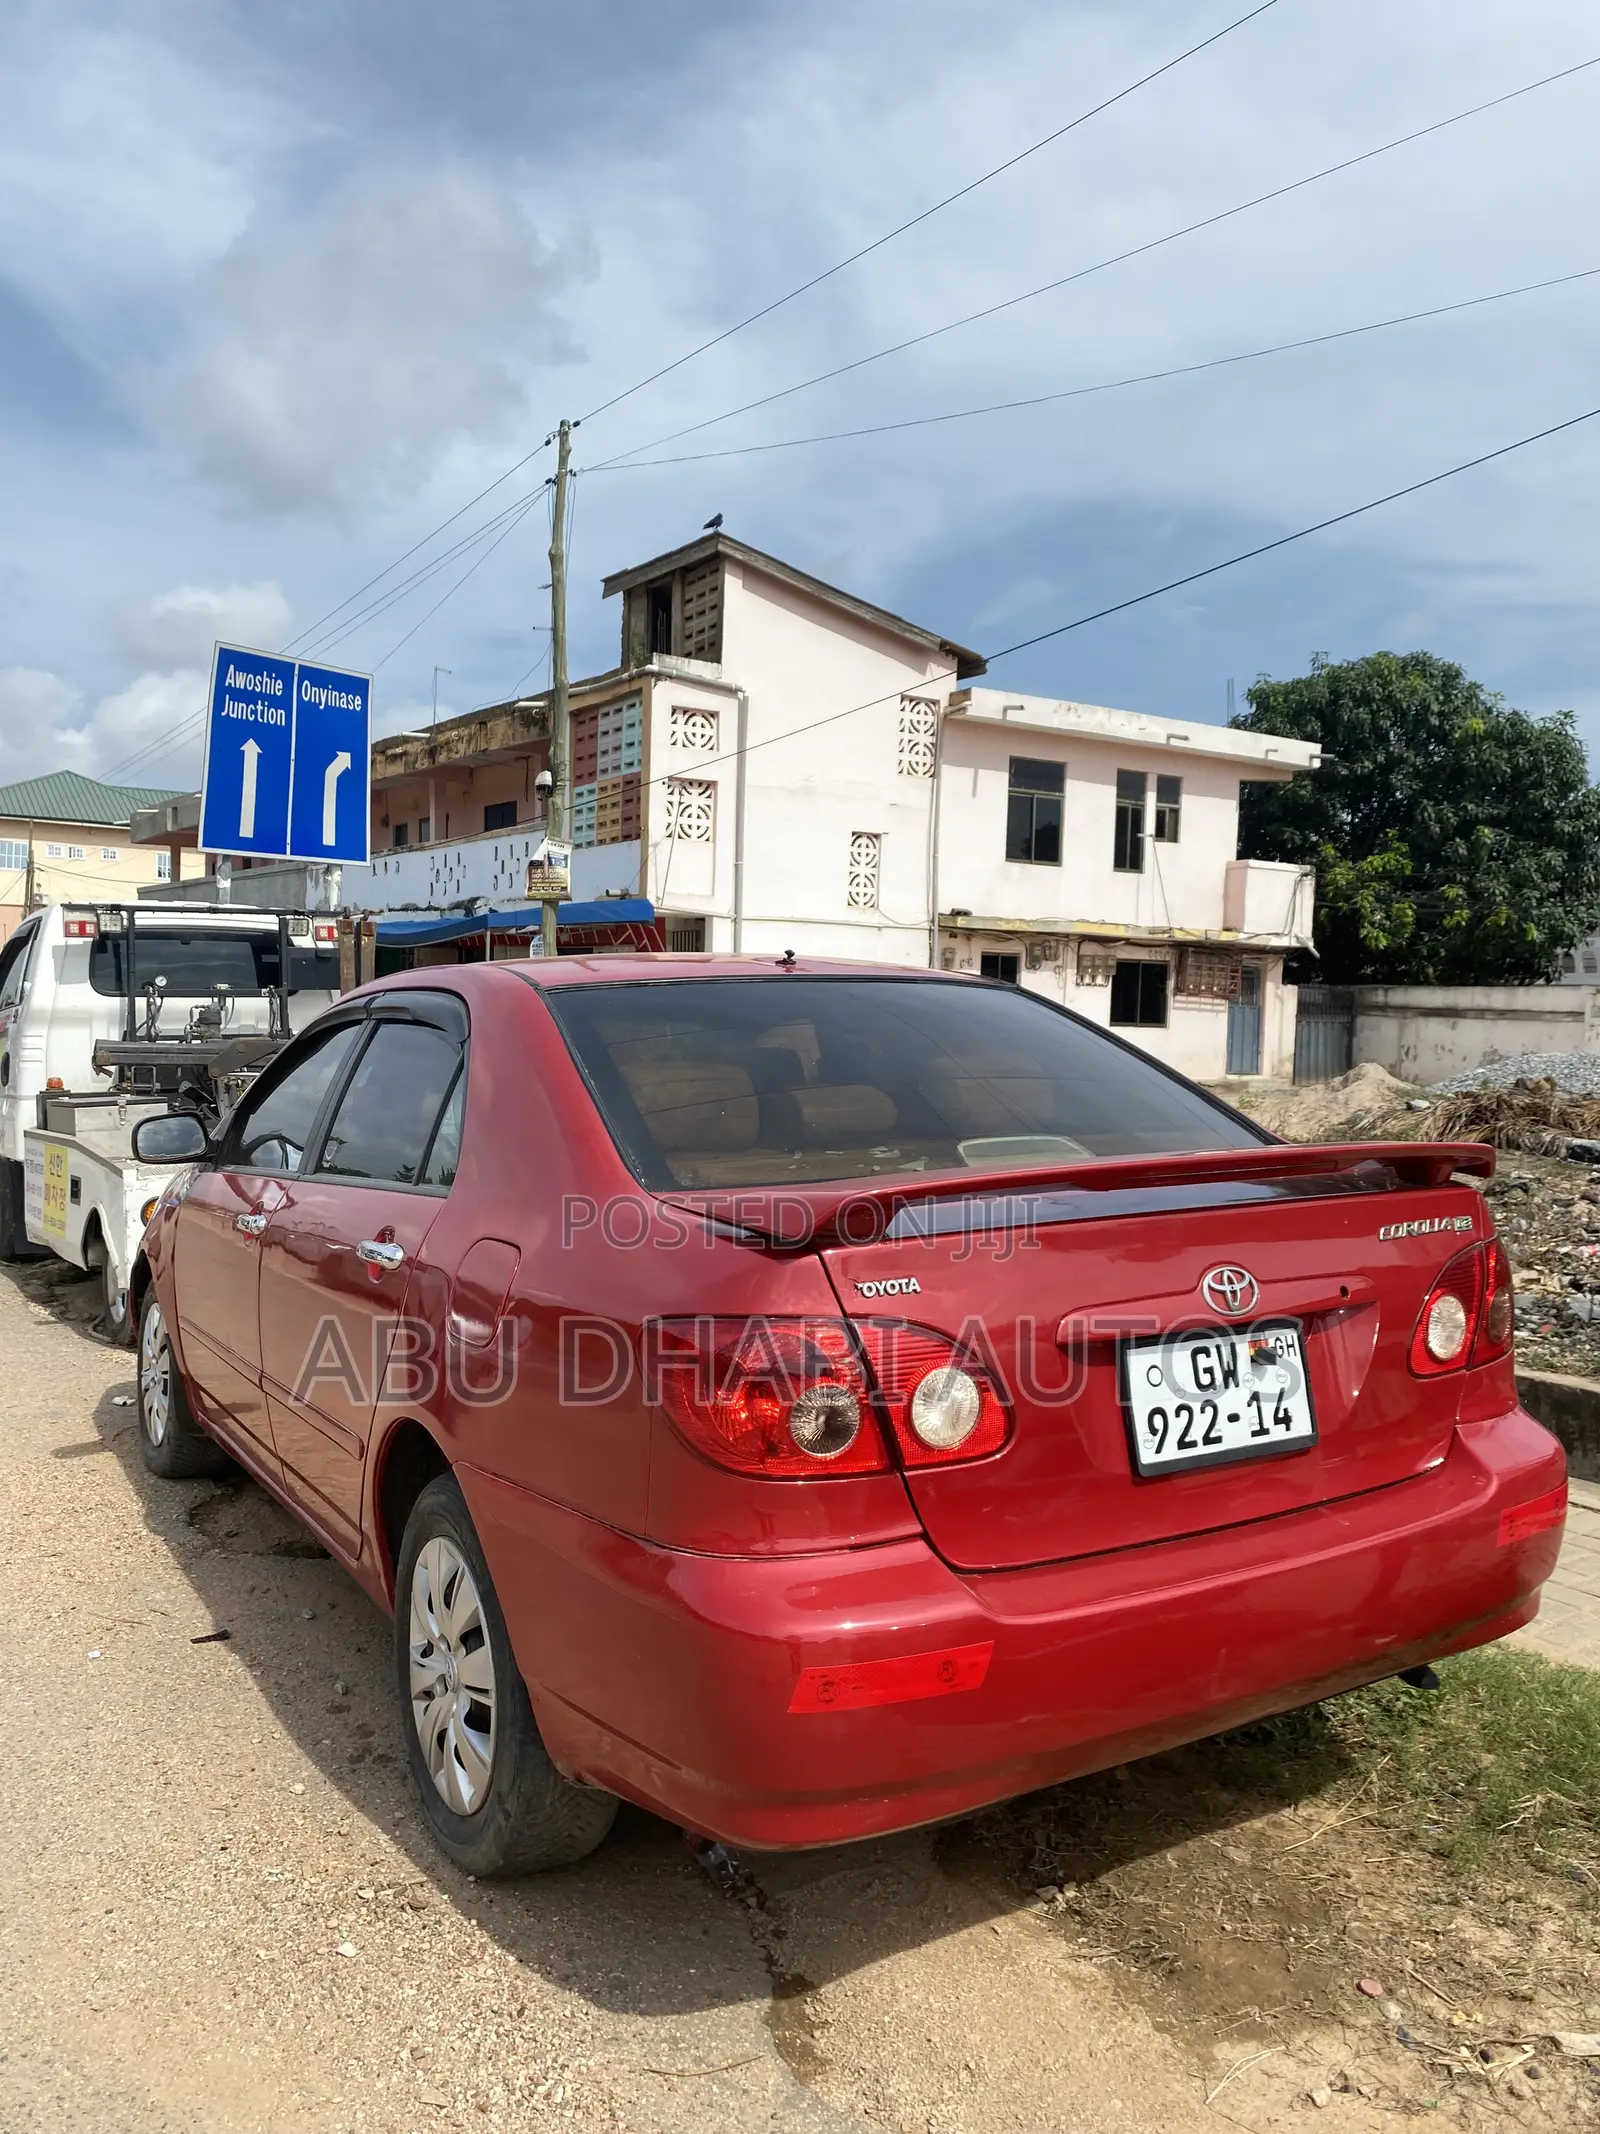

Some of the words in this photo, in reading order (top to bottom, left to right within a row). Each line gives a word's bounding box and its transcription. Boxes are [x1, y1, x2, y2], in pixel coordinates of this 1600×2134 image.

[225, 664, 283, 697] Awoshie
[301, 679, 362, 711] Onyinase
[221, 694, 286, 726] Junction
[1273, 1335, 1297, 1358] GH
[1190, 1342, 1240, 1392] GW
[1147, 1387, 1293, 1454] 922-14
